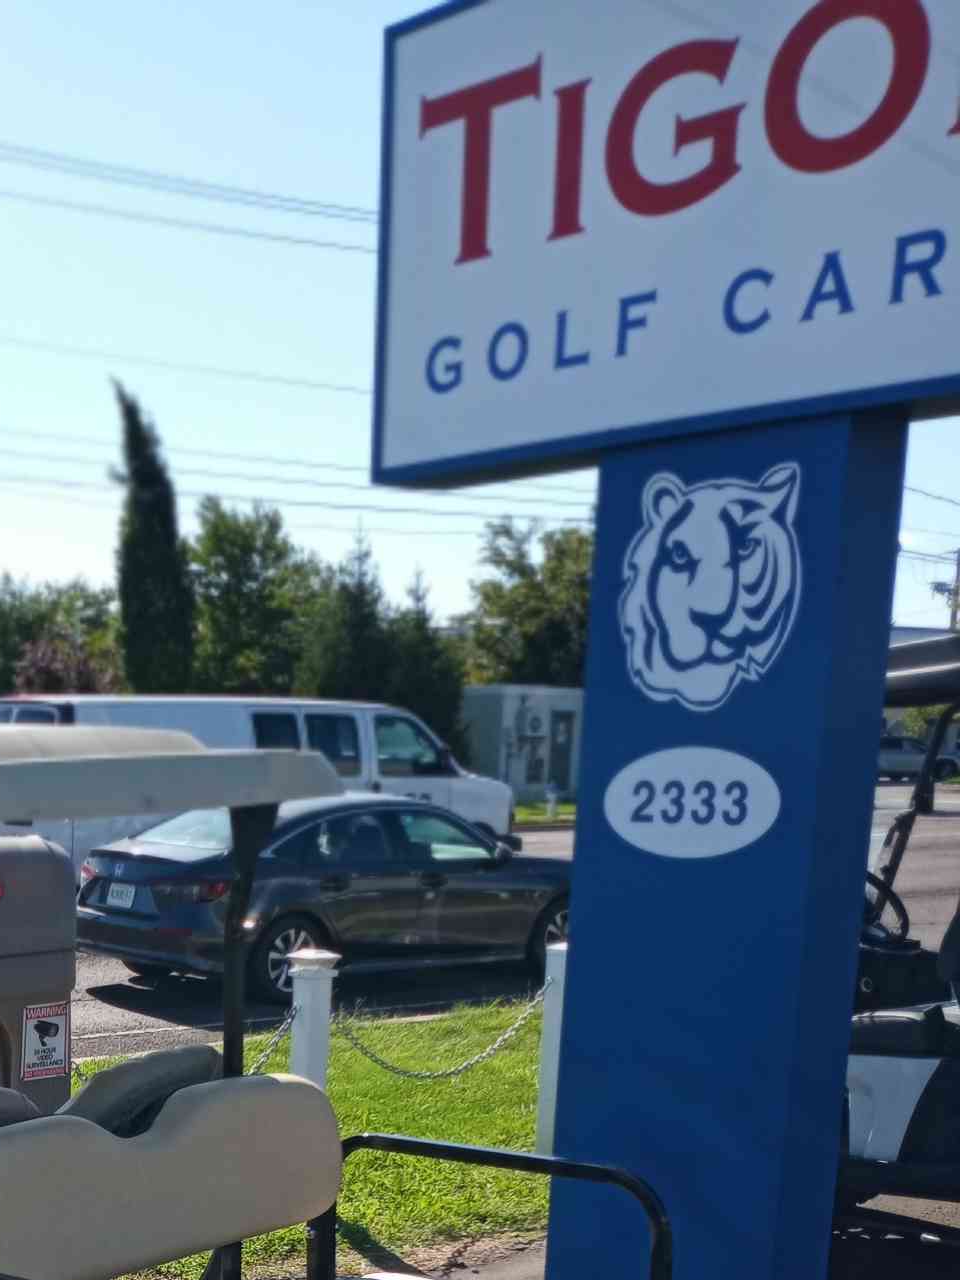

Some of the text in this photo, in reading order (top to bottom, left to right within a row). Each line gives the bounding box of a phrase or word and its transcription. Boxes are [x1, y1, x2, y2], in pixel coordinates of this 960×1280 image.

[419, 0, 960, 265] TIGO
[425, 228, 947, 394] GOLF CAR
[630, 779, 749, 826] 2333
[26, 1006, 65, 1019] WARNING
